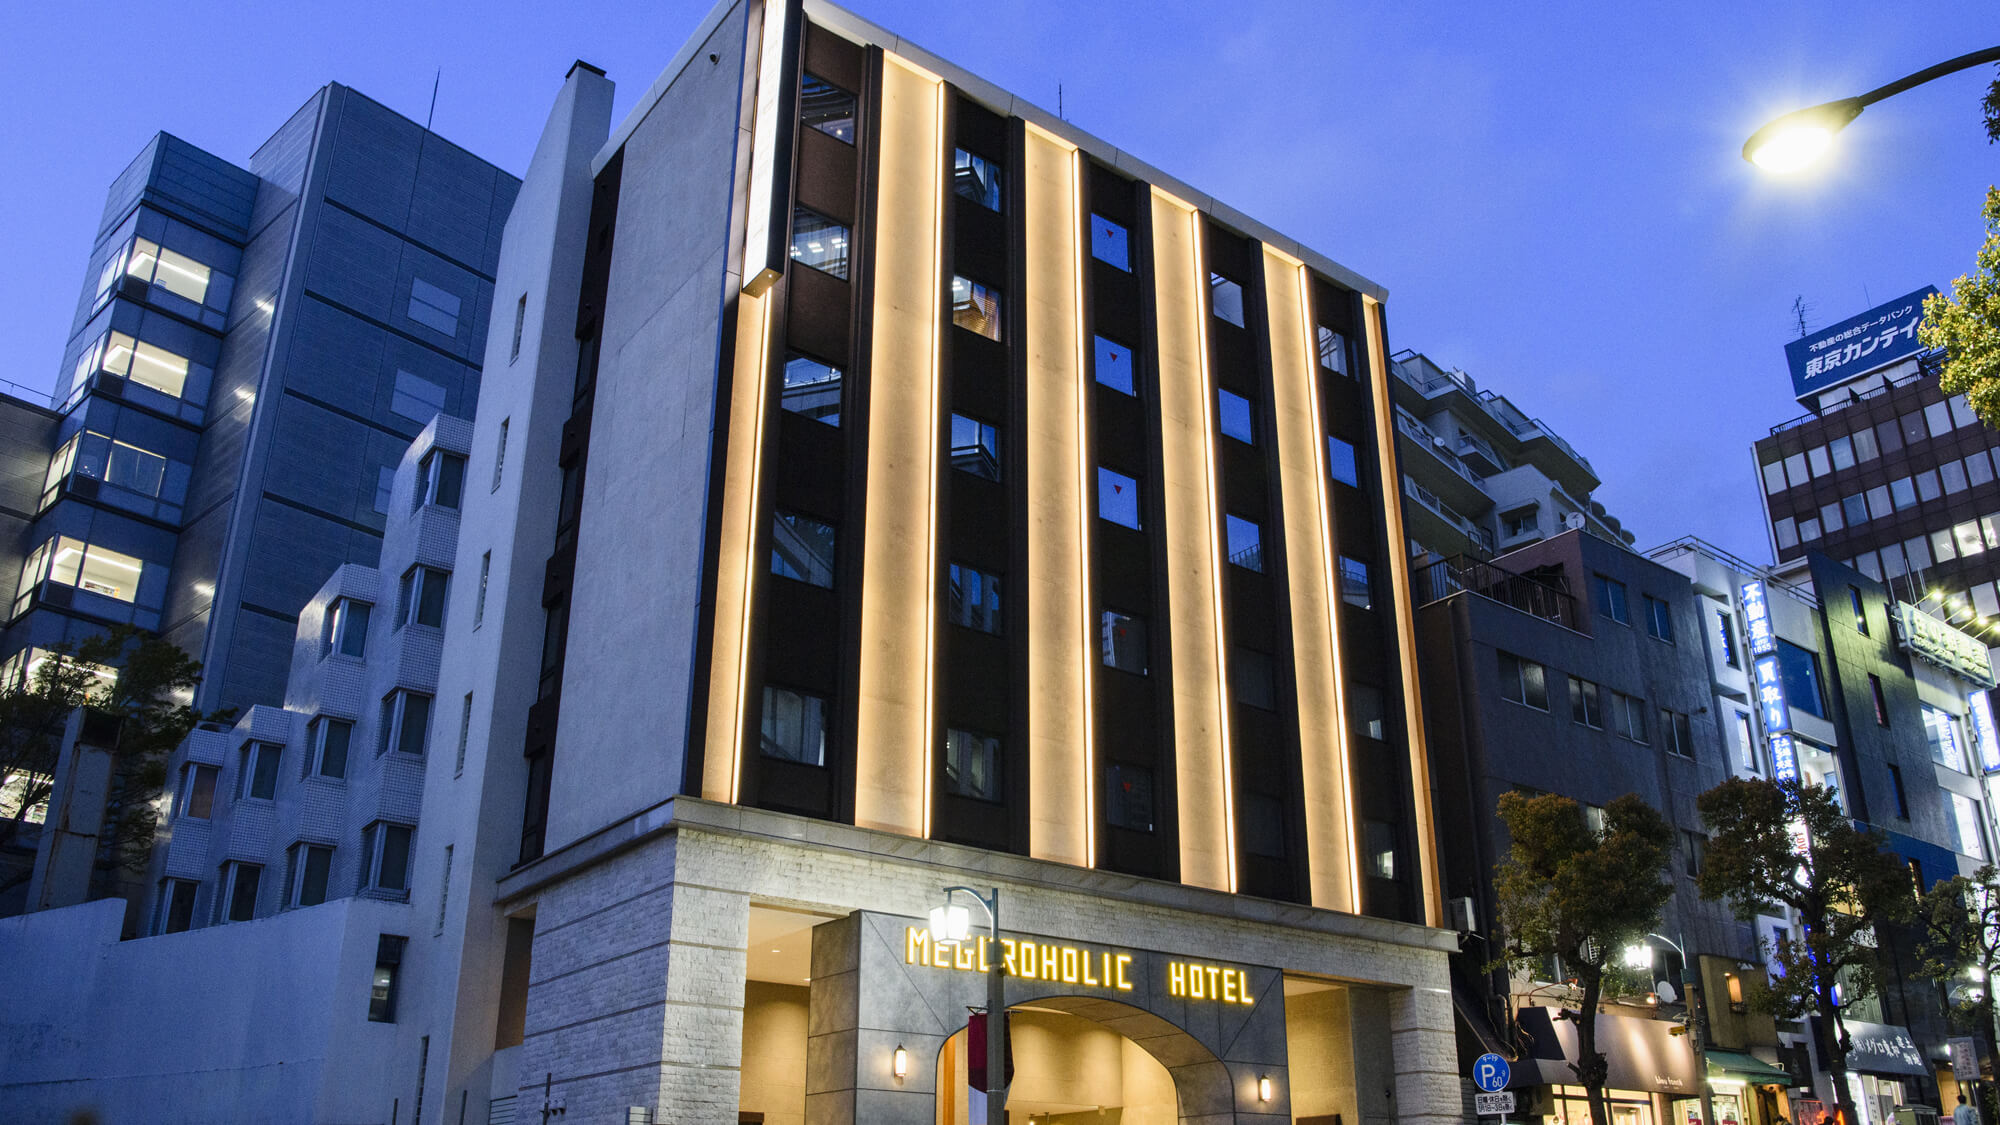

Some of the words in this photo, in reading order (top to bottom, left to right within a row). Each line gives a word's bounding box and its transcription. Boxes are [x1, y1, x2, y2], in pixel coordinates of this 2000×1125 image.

[1804, 316, 1919, 380] 東京カンテイ
[1809, 305, 1913, 353] 不動産の総合データバンク
[1743, 582, 1769, 640] 不動産
[1757, 660, 1783, 728] 買取り
[1169, 961, 1254, 1005] HOTEL
[1481, 1064, 1496, 1089] P
[1492, 1076, 1503, 1088] 60
